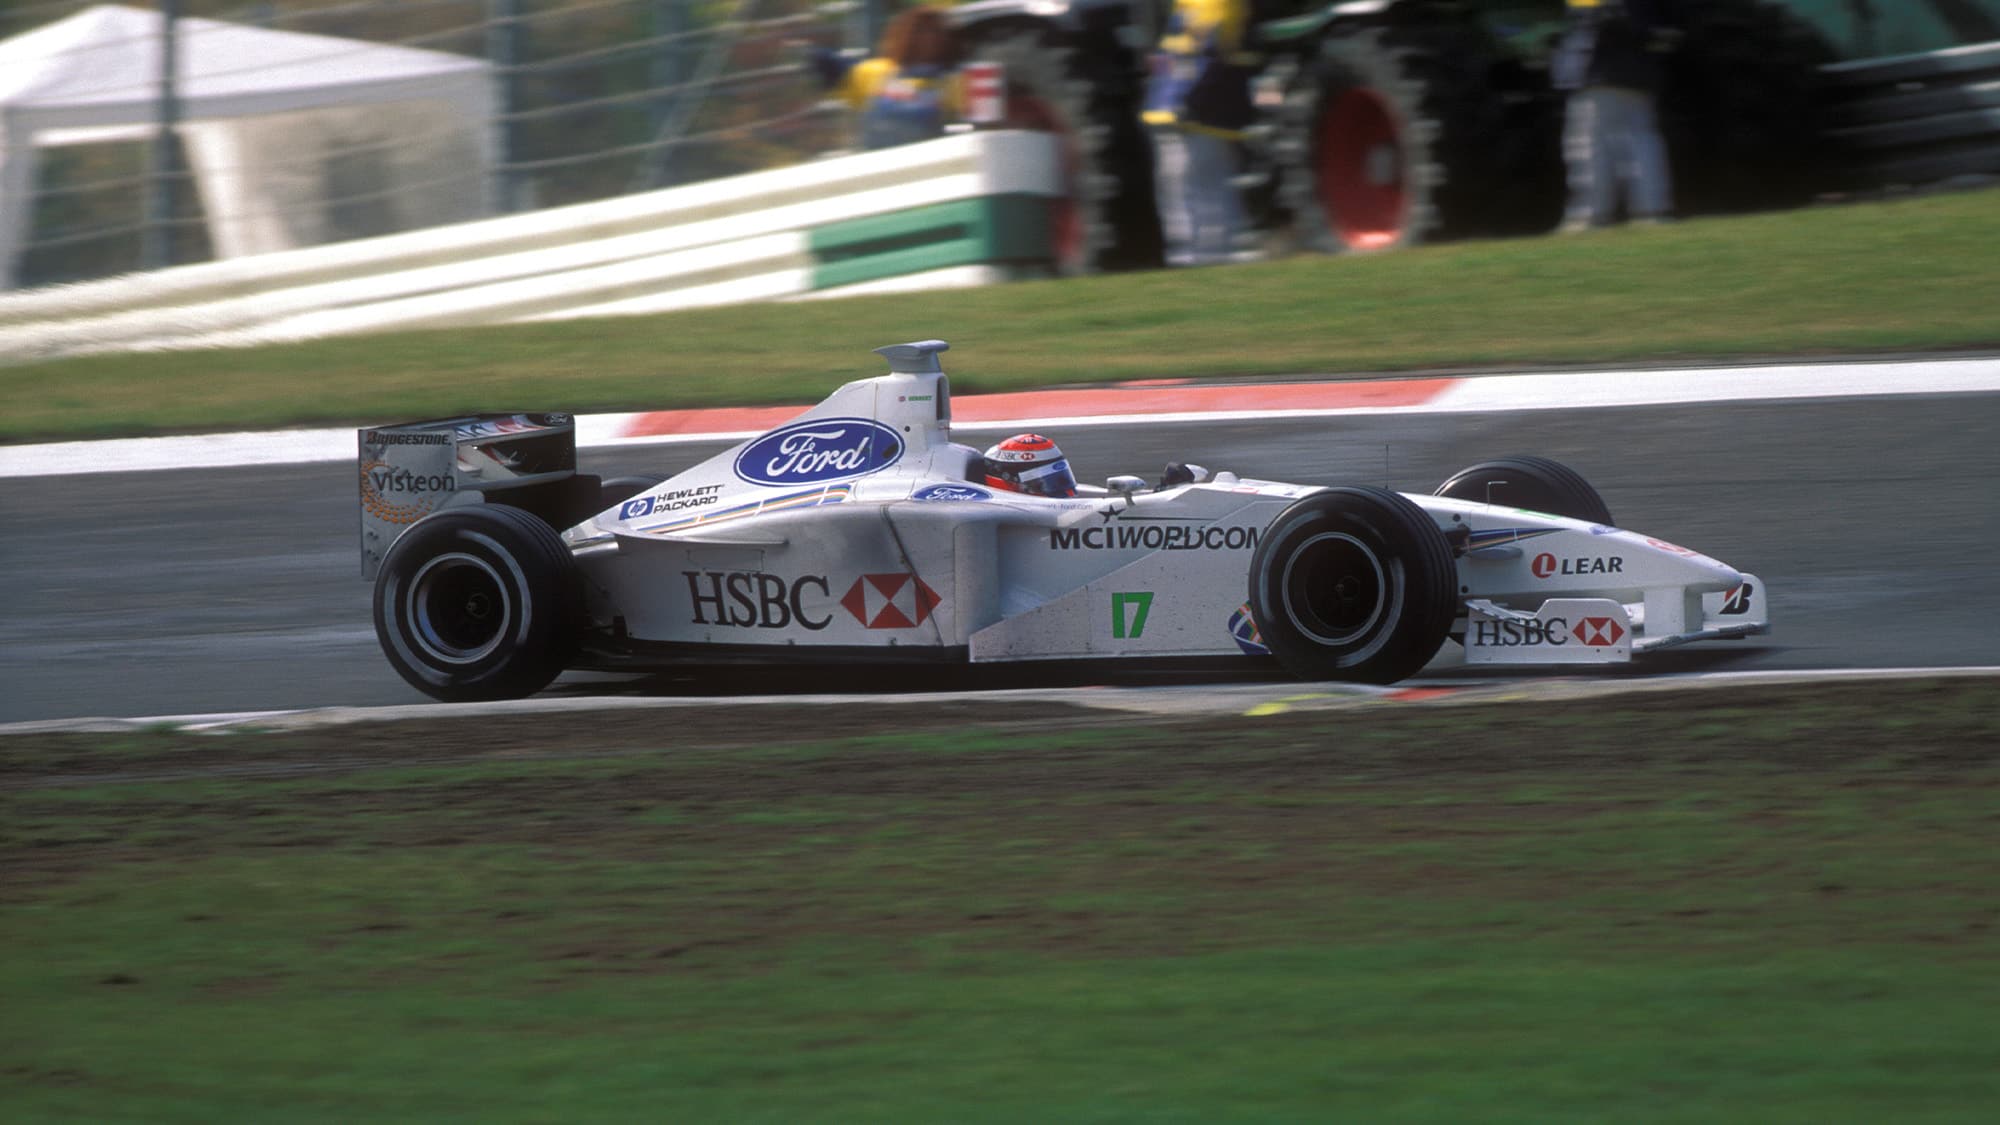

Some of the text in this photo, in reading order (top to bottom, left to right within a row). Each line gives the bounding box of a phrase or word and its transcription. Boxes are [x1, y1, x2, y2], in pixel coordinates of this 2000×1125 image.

[366, 431, 450, 446] BRIDGESTONE
[766, 428, 869, 478] Ford
[373, 470, 455, 492] Visteon
[657, 485, 721, 503] HEWLETT
[925, 487, 977, 501] Ford
[653, 496, 718, 514] PACKARD
[1561, 556, 1623, 575] LEAR
[682, 571, 833, 631] HSBC
[1111, 592, 1154, 639] 17
[1474, 617, 1569, 648] HSBC
